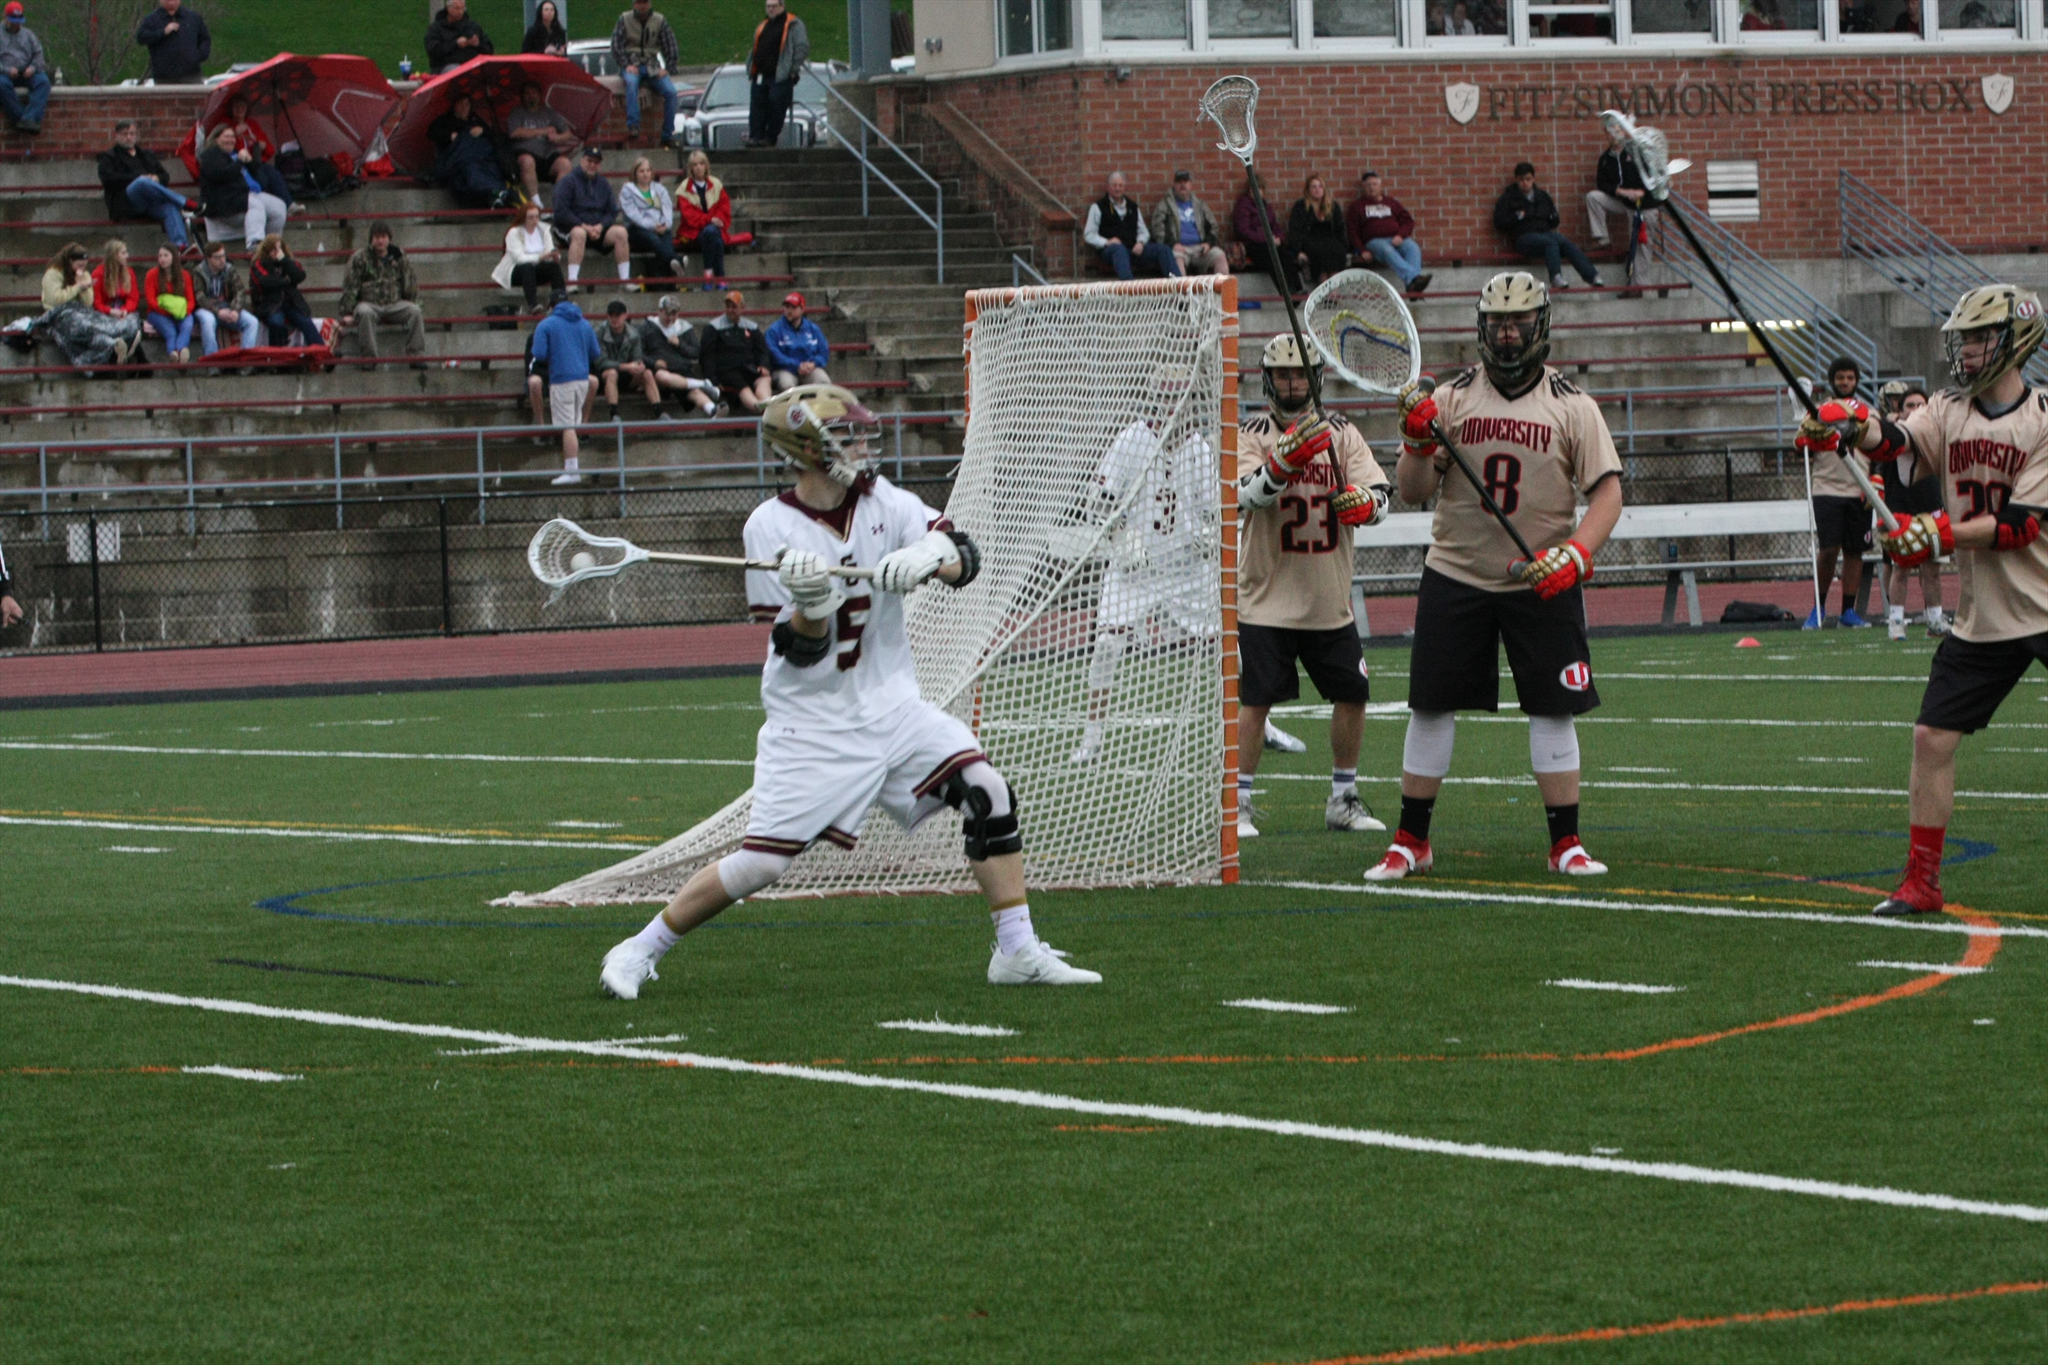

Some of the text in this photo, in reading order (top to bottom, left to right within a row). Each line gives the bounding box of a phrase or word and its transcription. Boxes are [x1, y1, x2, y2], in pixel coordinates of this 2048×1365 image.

[1487, 78, 1975, 120] FITZSIMMONS PRESS BOX
[1460, 416, 1552, 454] UNIVERSITY
[1949, 438, 2028, 480] UNIVERSITY
[1481, 452, 1522, 516] 8
[1280, 495, 1339, 554] 23
[836, 594, 871, 673] 5
